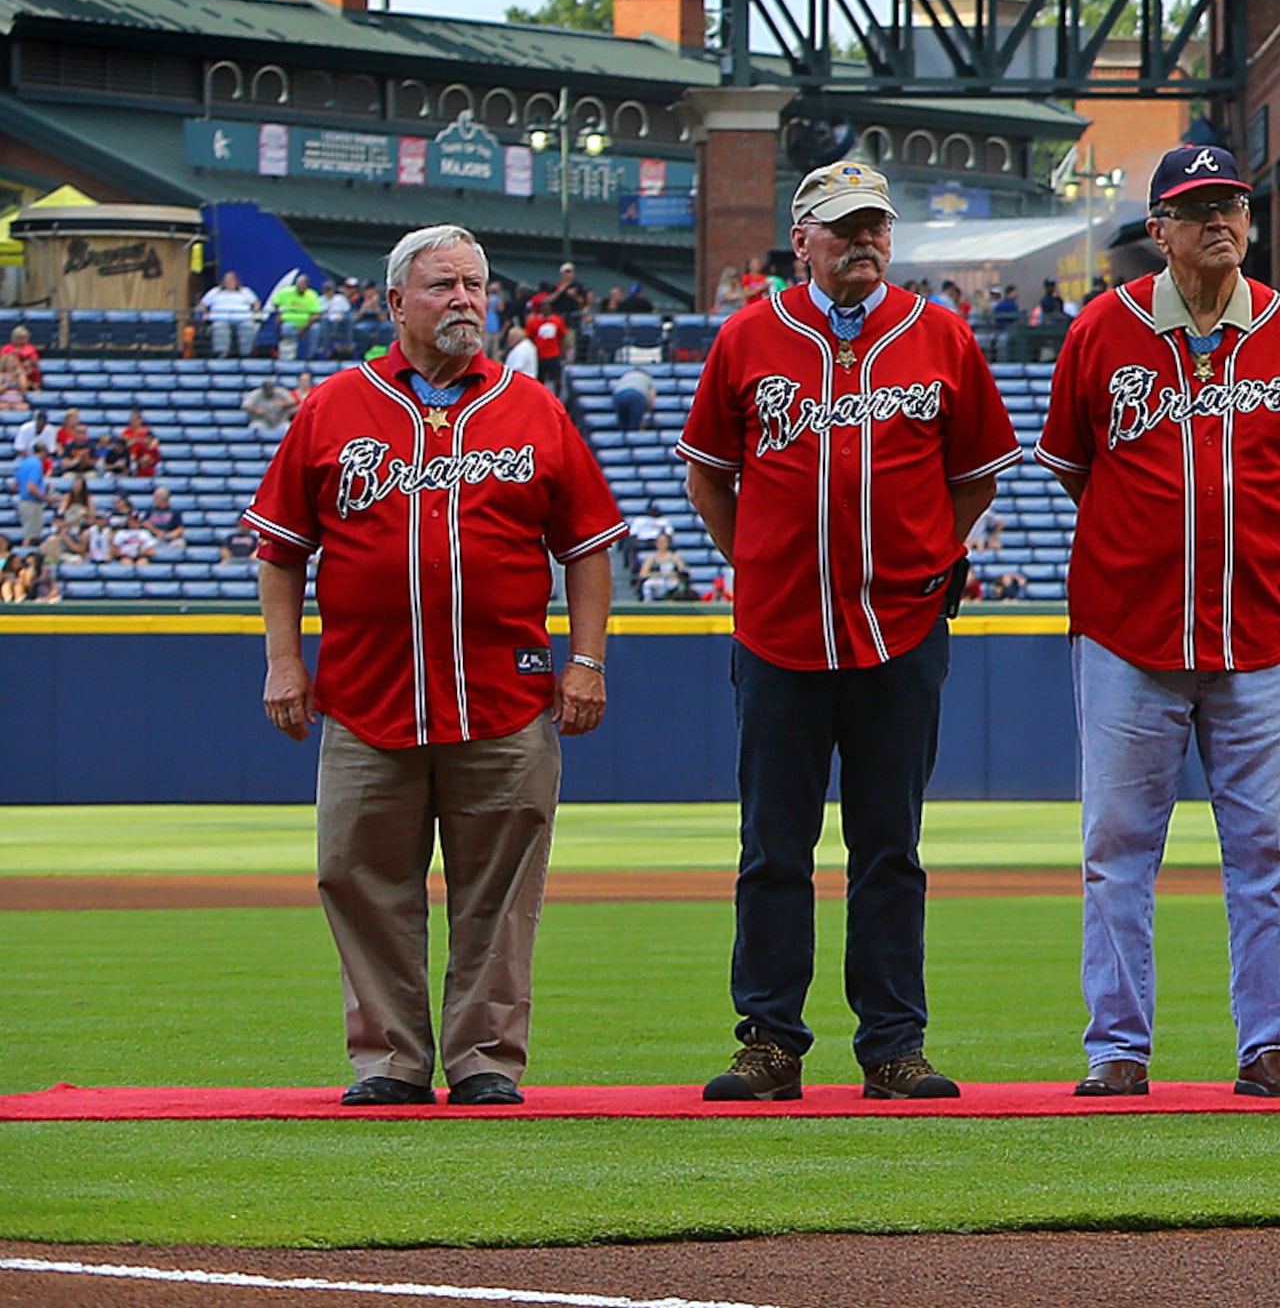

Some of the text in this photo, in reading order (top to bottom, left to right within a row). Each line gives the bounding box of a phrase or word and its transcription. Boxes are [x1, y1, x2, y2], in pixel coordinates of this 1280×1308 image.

[1184, 148, 1220, 175] A
[754, 375, 942, 458] Braves
[336, 436, 535, 520] Braves
